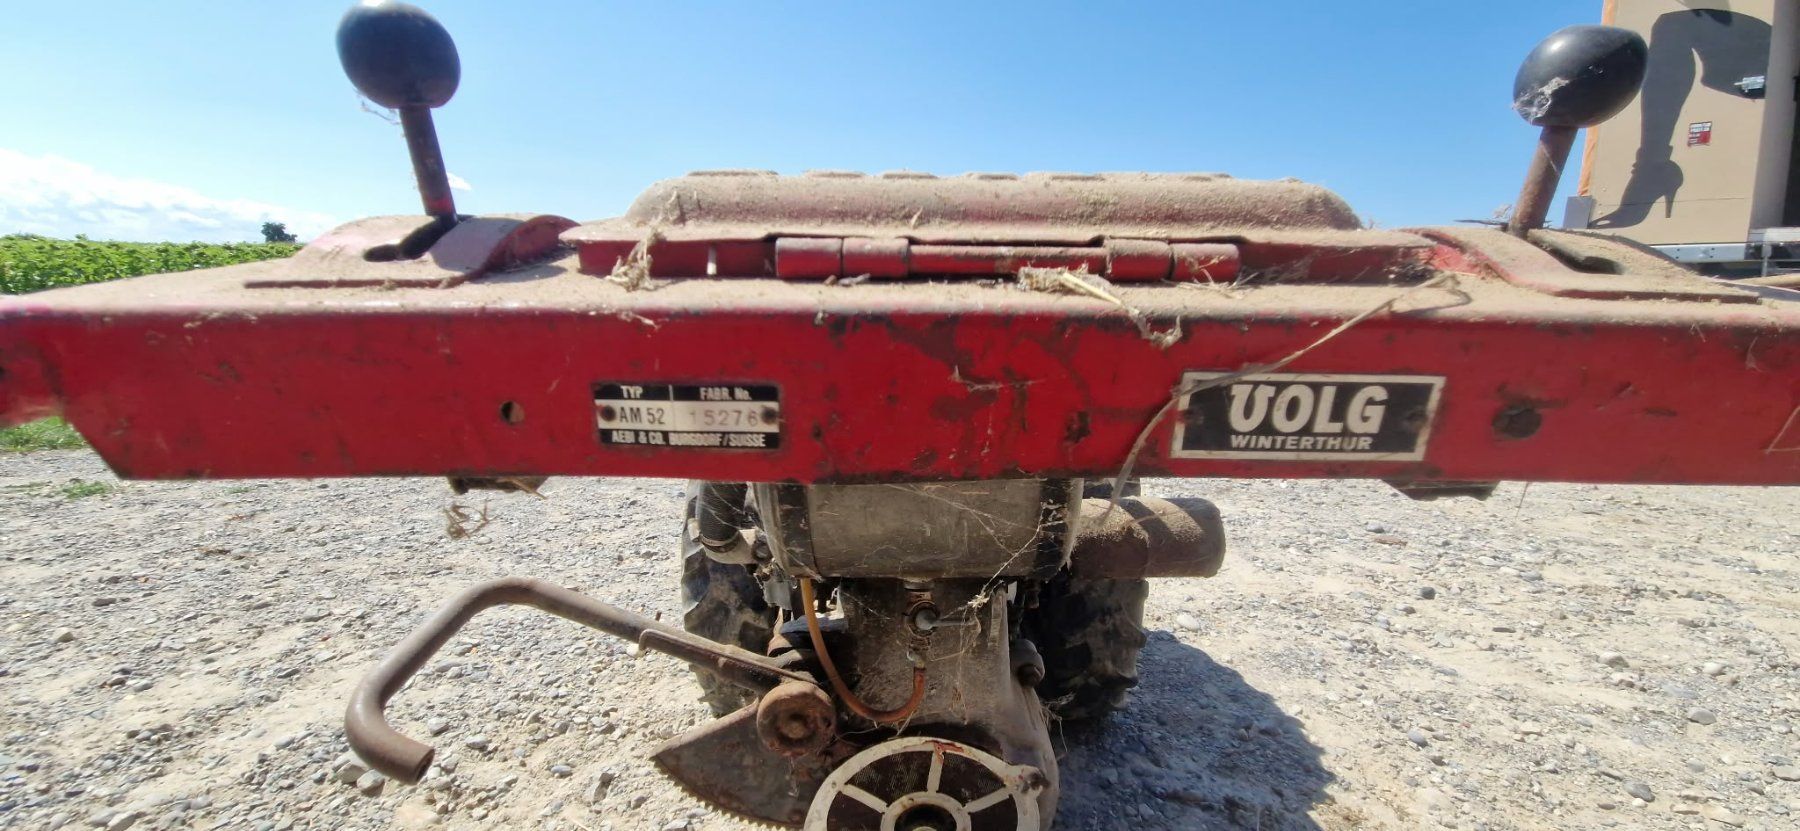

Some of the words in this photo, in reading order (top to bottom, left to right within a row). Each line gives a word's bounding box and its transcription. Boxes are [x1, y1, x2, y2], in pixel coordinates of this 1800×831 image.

[620, 385, 643, 399] TYP
[700, 387, 732, 401] FABR.
[619, 406, 642, 424] AM
[647, 407, 666, 425] 52
[612, 429, 635, 444] AEBI
[638, 430, 648, 444] &
[1229, 434, 1374, 451] WINTERTHUR
